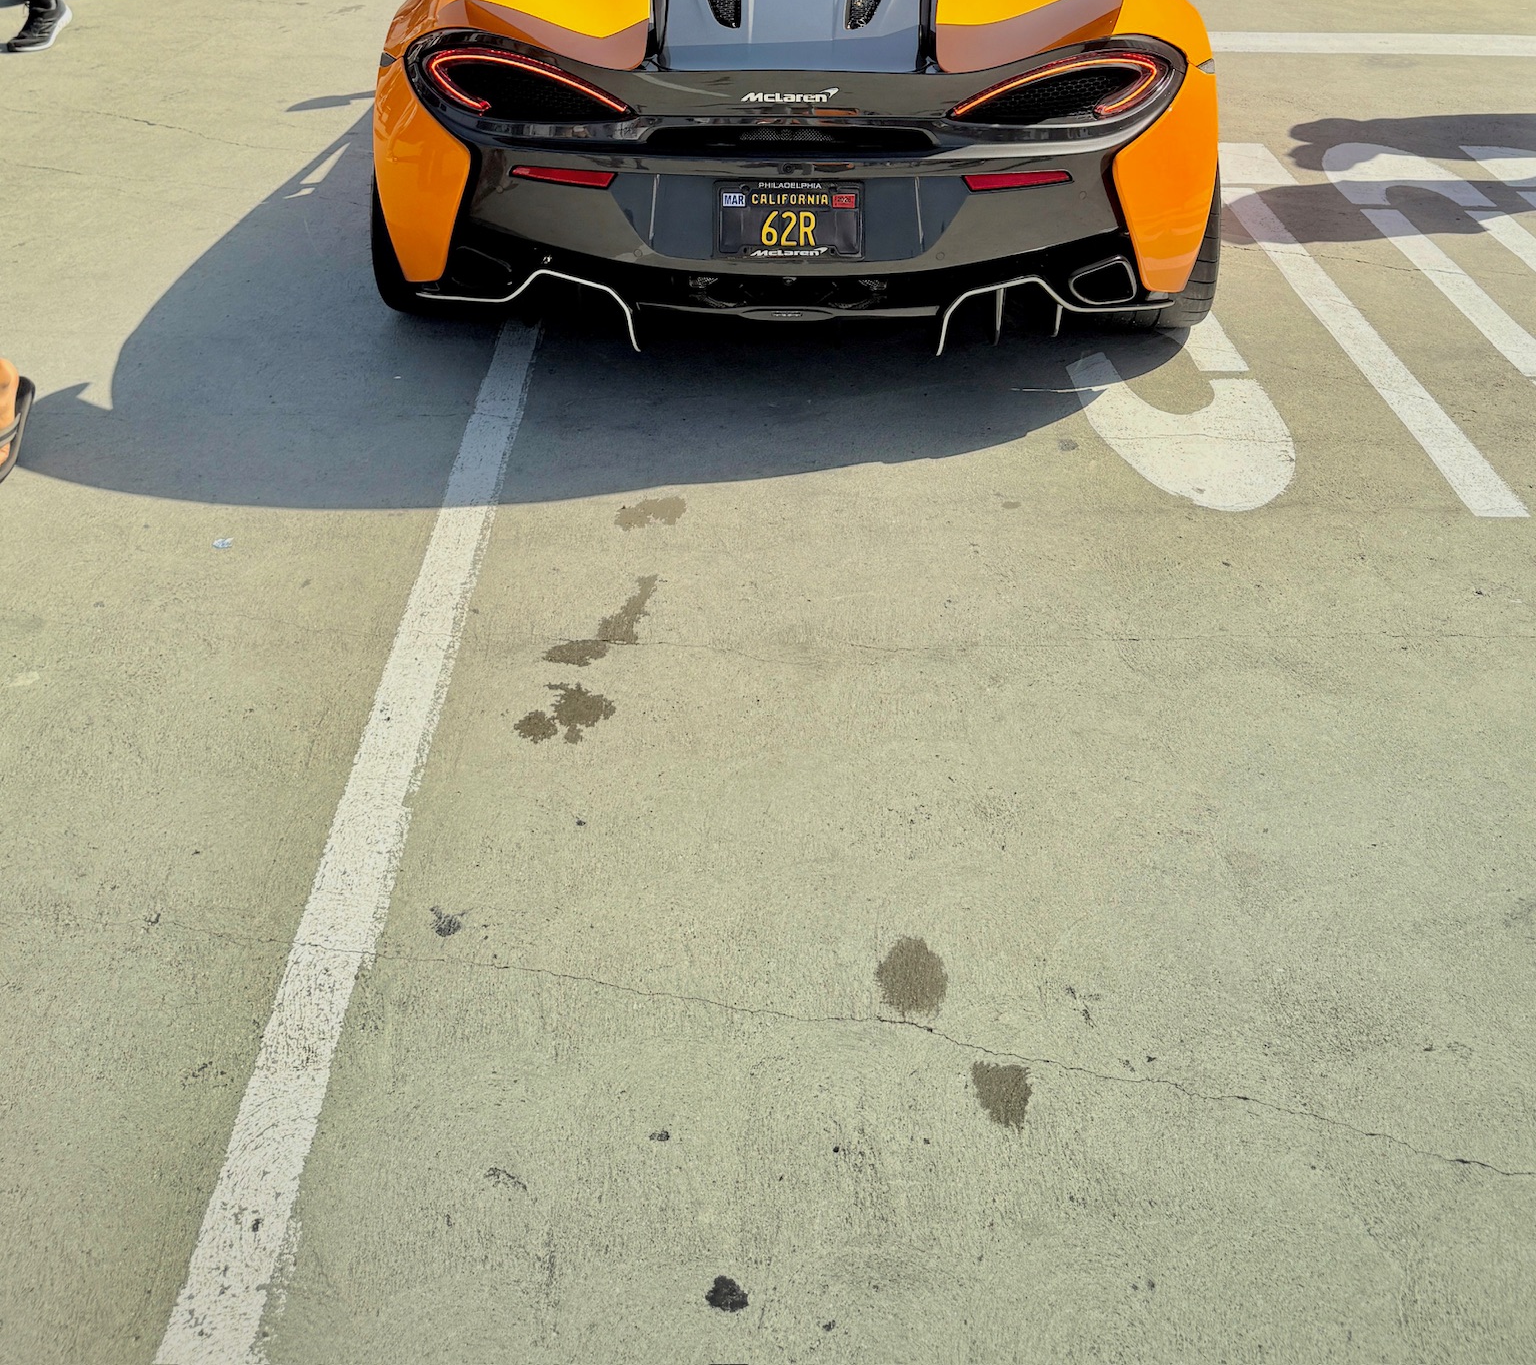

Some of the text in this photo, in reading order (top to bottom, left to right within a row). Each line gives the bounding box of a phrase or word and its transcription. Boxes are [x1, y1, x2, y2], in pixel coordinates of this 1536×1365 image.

[758, 181, 822, 190] PHILADELPHIA
[724, 194, 745, 206] MAR
[751, 193, 829, 205] CALIFORNIA
[761, 210, 817, 247] 62R
